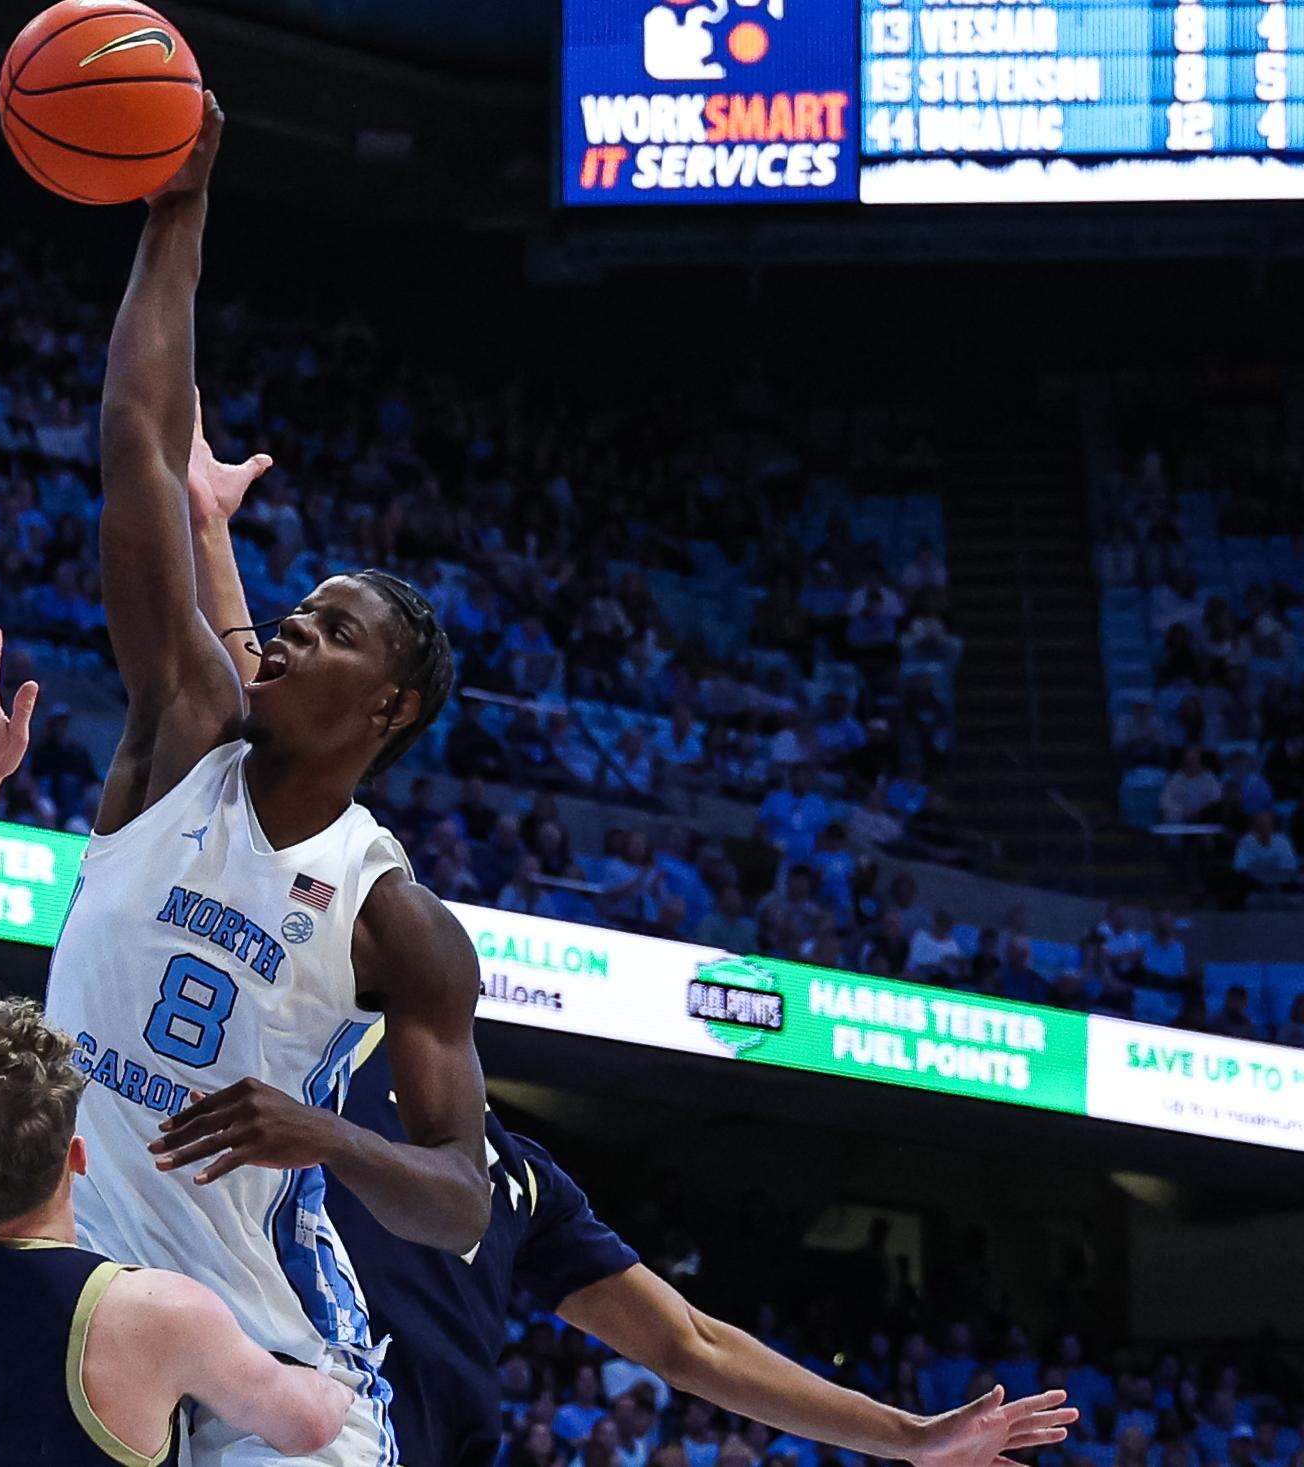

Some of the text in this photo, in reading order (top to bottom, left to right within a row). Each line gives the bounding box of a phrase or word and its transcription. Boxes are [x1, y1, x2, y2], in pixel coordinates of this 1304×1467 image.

[871, 3, 1287, 53] 13 VEESAAR 8 4
[871, 51, 1287, 102] 15 STEVENSON 8 5
[580, 92, 848, 144] WORKSMART
[866, 106, 915, 150] 44
[1166, 101, 1214, 150] 12
[1257, 101, 1287, 150] 4
[580, 142, 840, 190] IT SERVICES
[156, 885, 286, 985] NORTH
[477, 930, 608, 977] GALLON
[143, 952, 240, 1070] 8
[808, 977, 1047, 1054] HARRIS TEETER
[832, 1022, 1031, 1091] FUEL POINTS
[1127, 1041, 1194, 1078] SAVE
[1204, 1054, 1240, 1083] UP
[1248, 1061, 1284, 1092] TO
